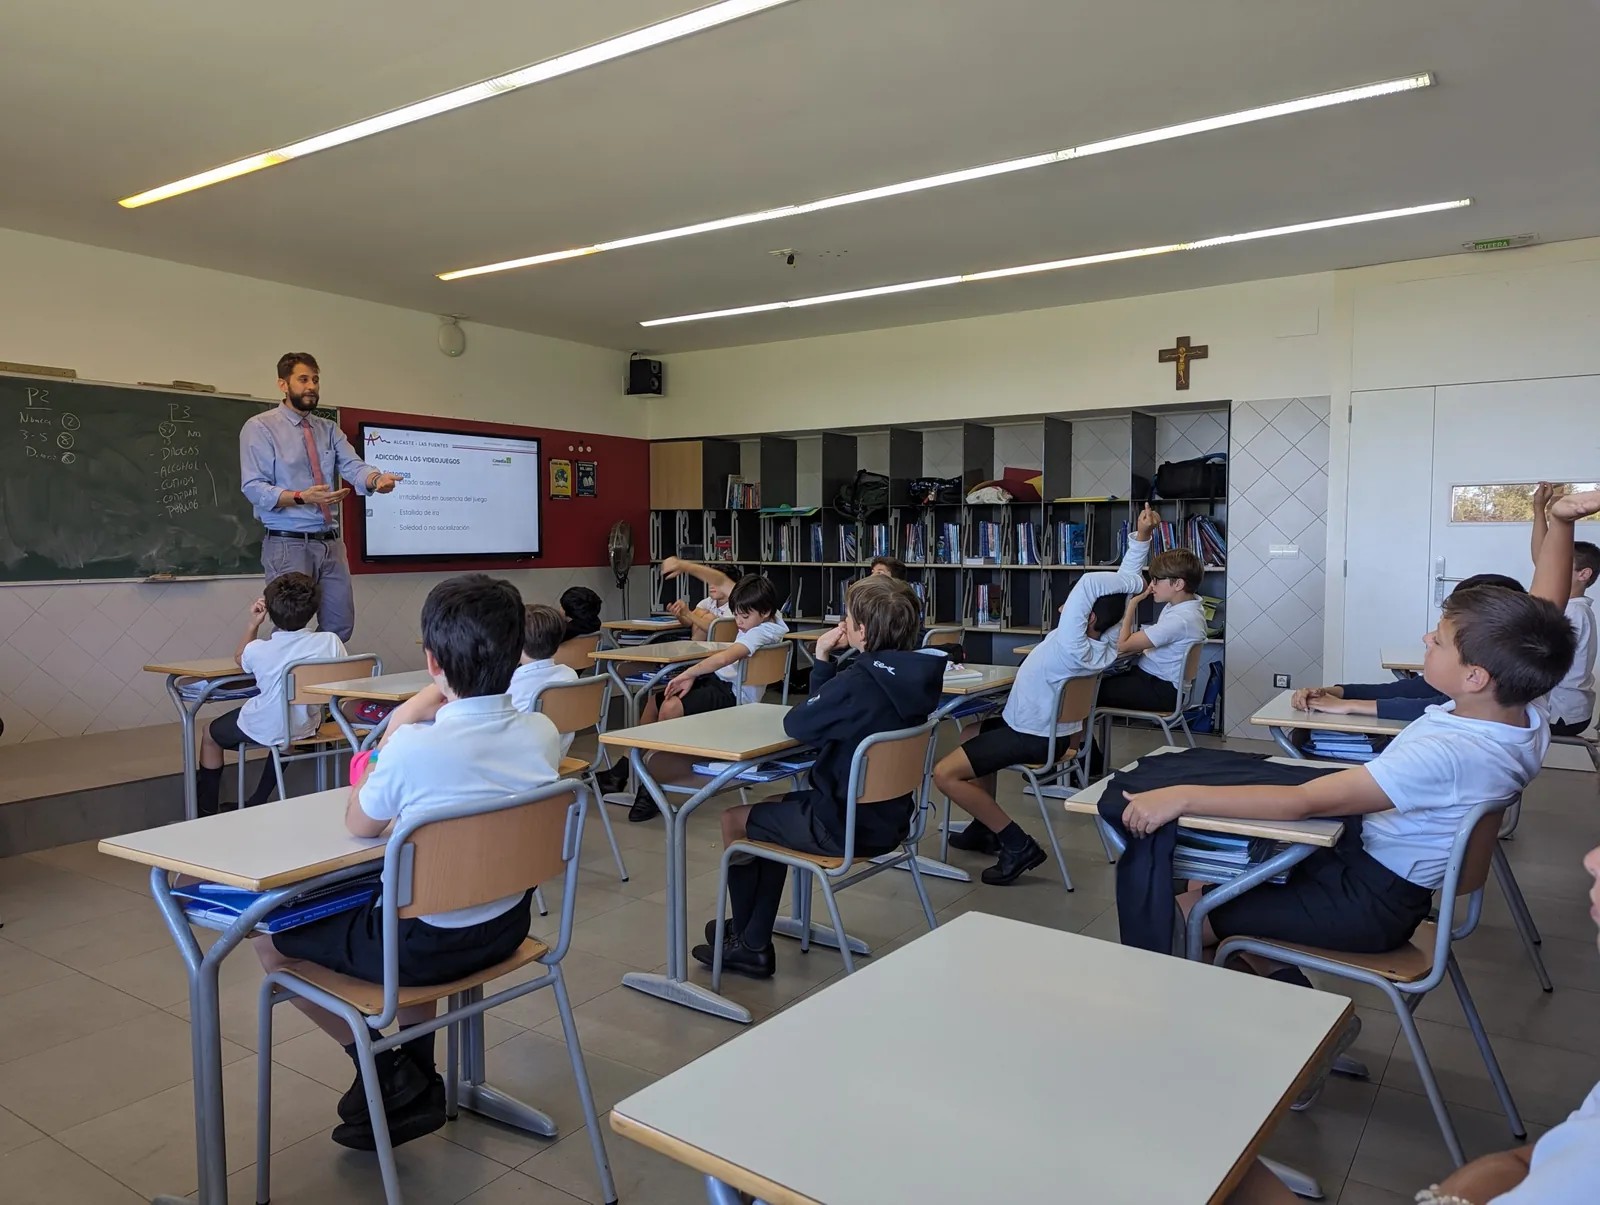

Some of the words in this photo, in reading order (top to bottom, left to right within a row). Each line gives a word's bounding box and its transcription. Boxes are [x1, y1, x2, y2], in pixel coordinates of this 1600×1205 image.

[1475, 241, 1508, 250] IRTEERA
[25, 386, 50, 406] P2
[168, 403, 191, 421] P3
[375, 453, 403, 461] ADICCIÓN
[422, 457, 460, 465] VIDEOJUEGOS
[160, 460, 200, 478] ALCOHOL
